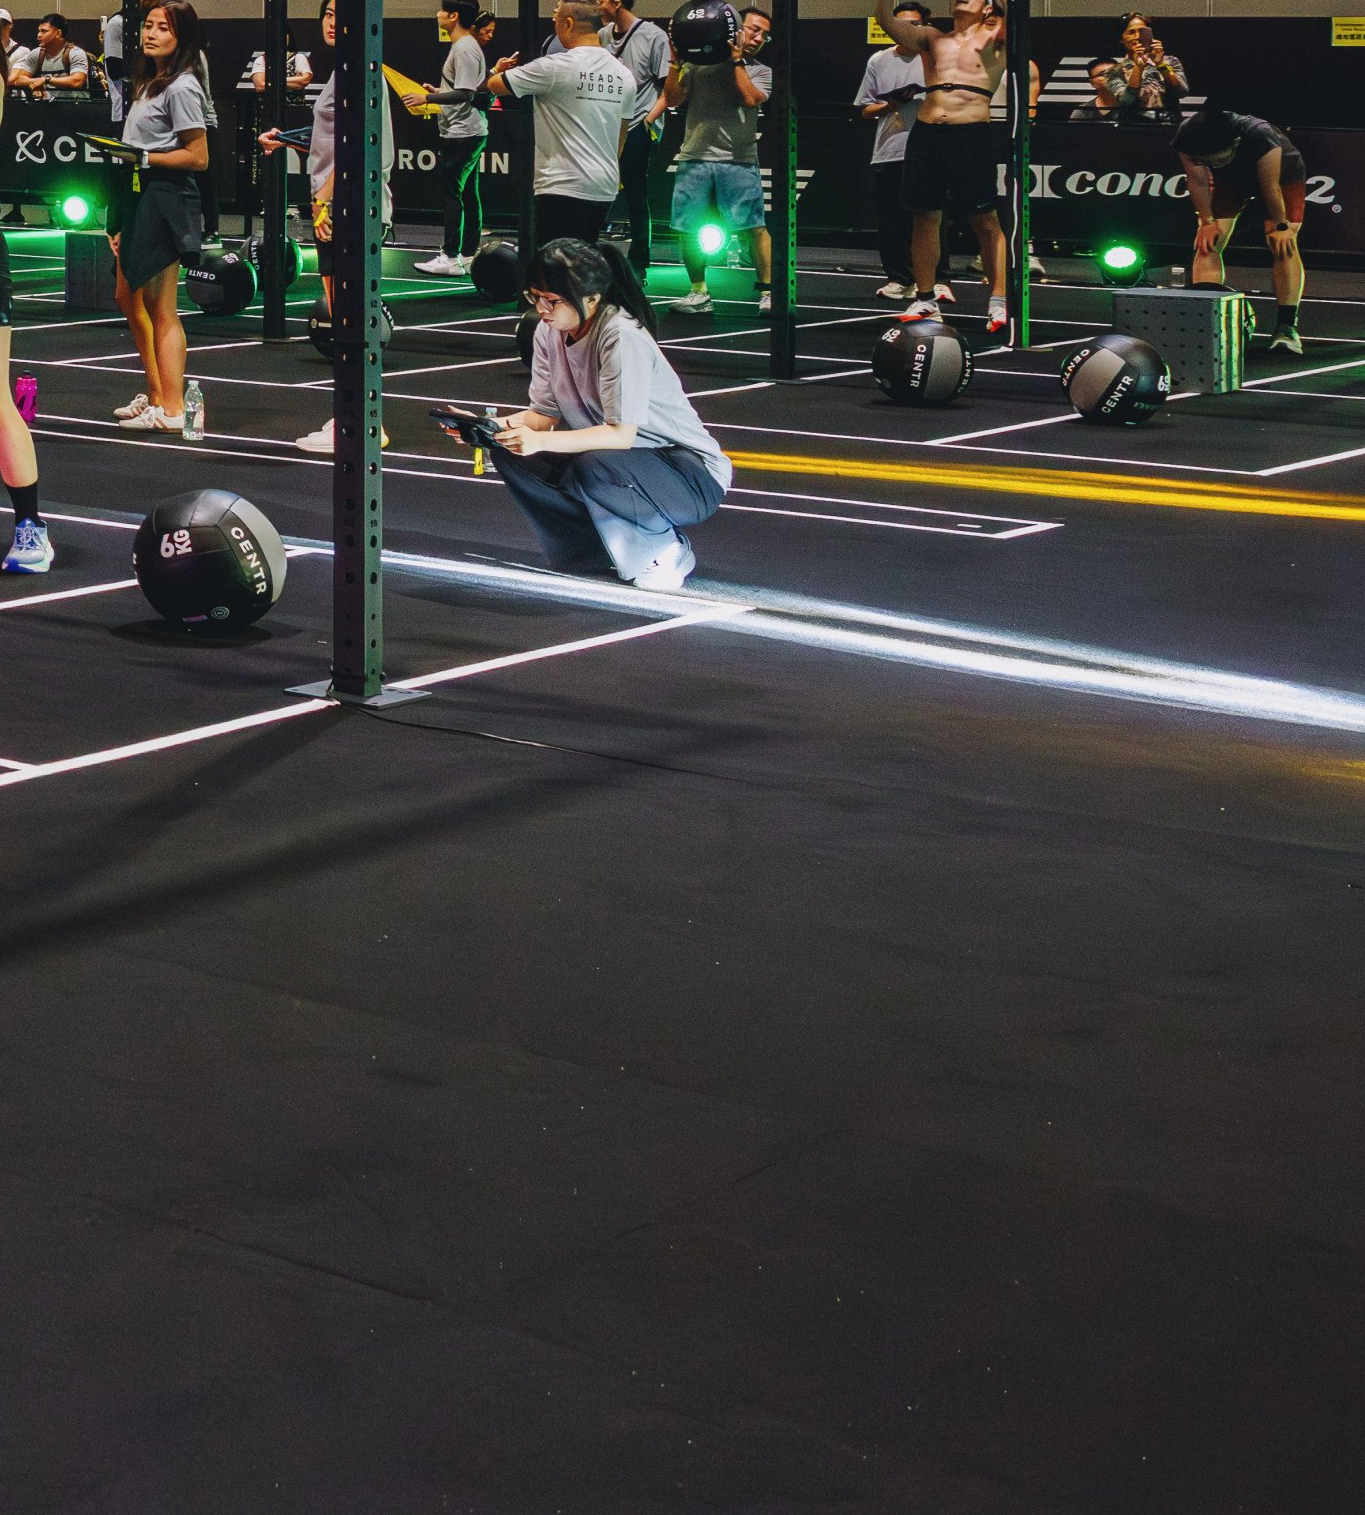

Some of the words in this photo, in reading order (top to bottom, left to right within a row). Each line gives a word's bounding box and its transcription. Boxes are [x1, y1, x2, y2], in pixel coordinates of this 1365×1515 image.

[576, 82, 624, 95] JUDGE
[579, 71, 614, 83] HEAD
[910, 343, 927, 388] CENTR
[1062, 349, 1090, 387] CENTR
[1101, 375, 1134, 416] CENTR
[160, 533, 177, 558] 6
[173, 529, 193, 555] KG
[229, 526, 268, 596] CENTR
